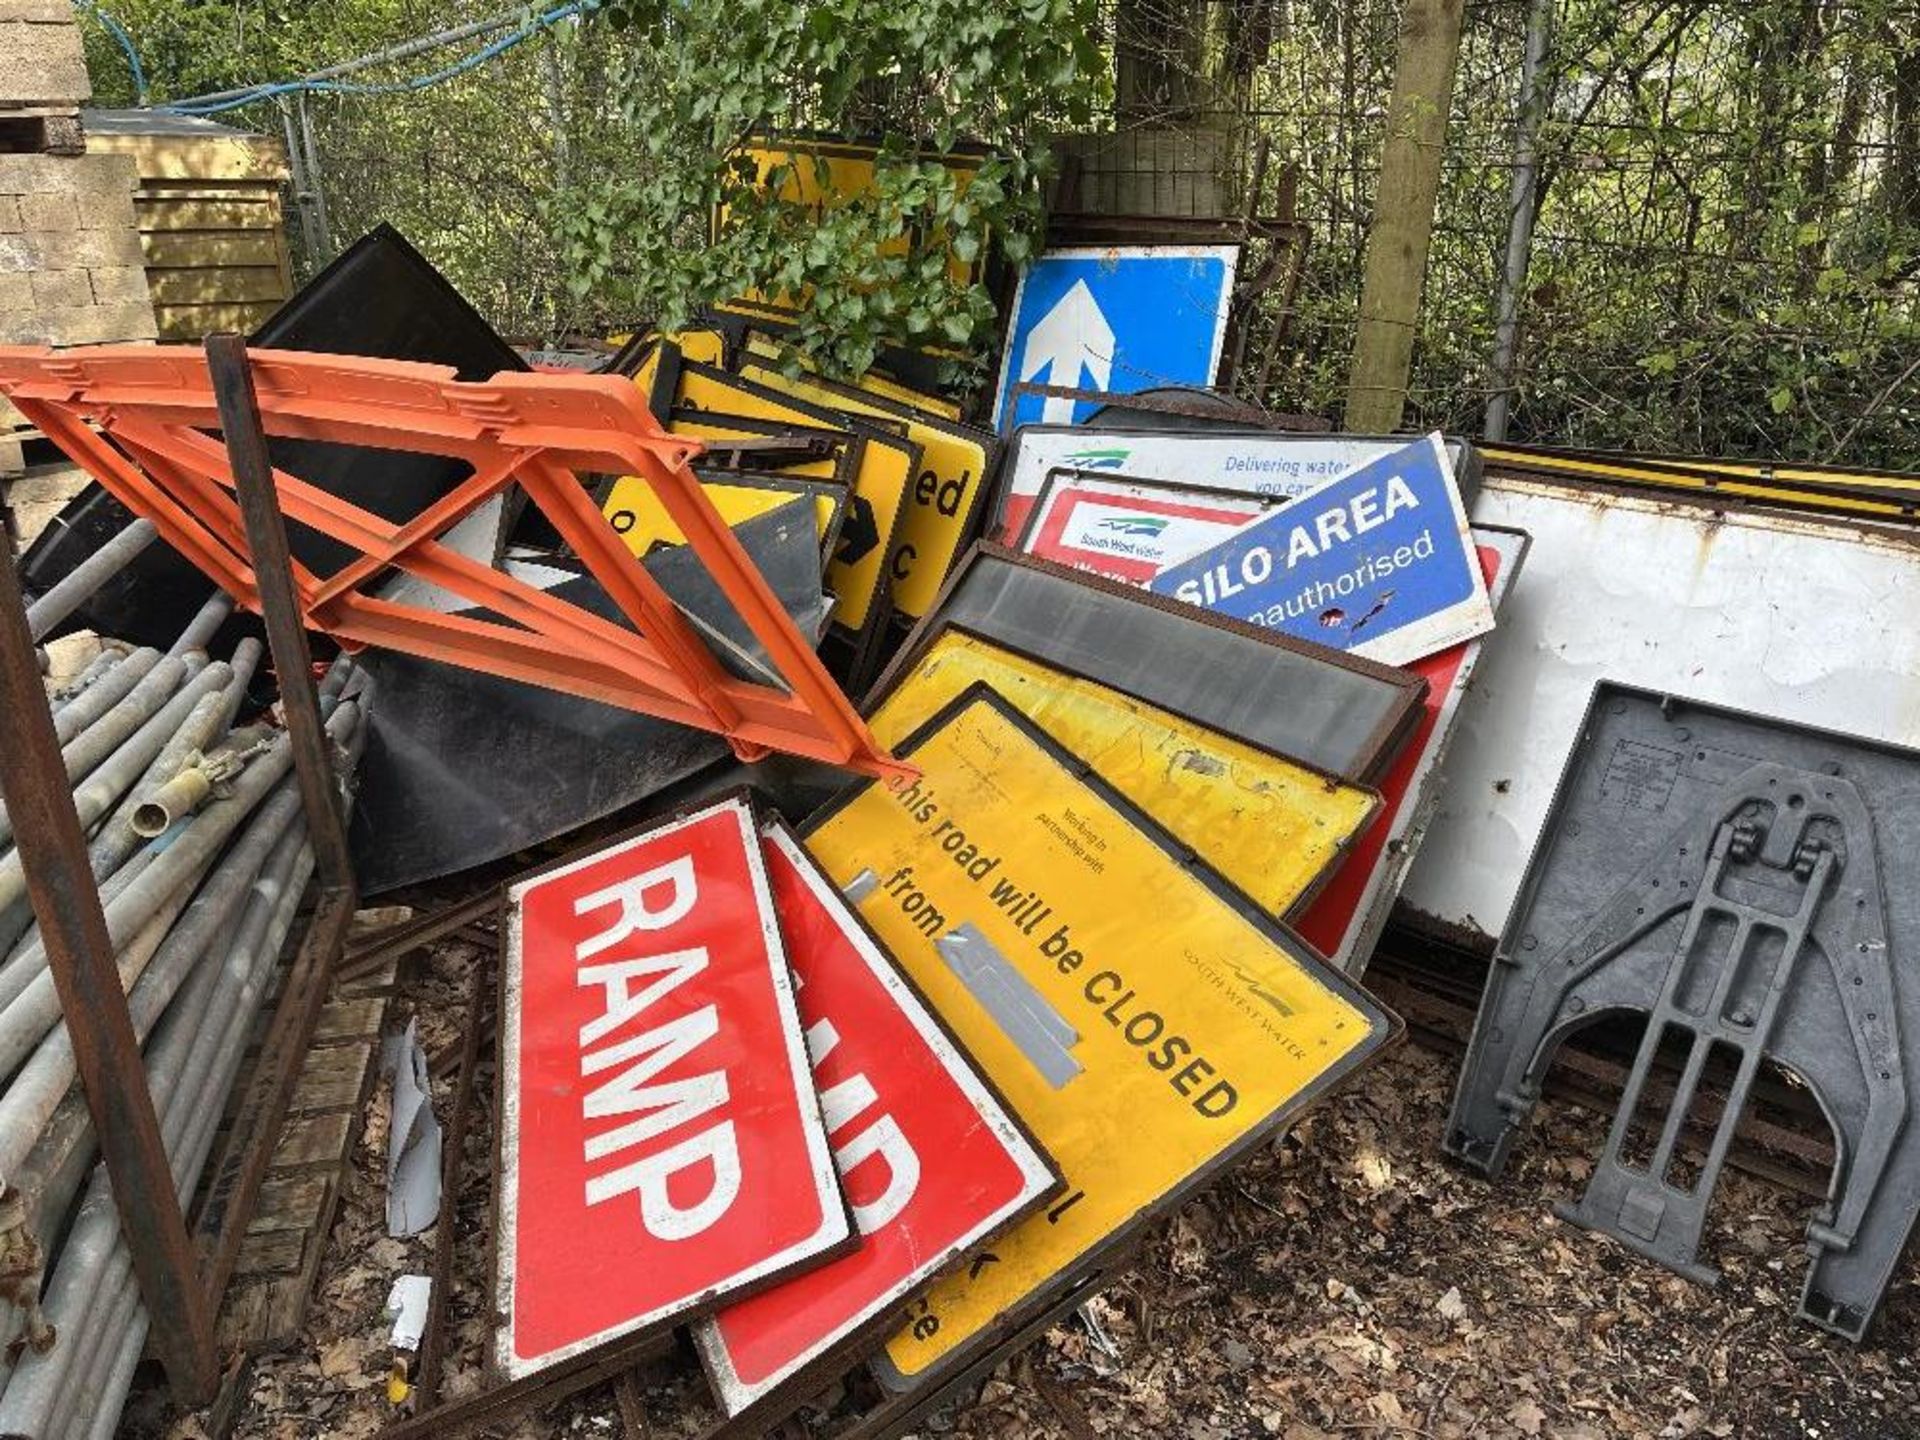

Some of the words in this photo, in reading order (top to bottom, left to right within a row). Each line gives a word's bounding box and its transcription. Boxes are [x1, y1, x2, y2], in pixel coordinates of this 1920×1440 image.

[916, 469, 970, 517] ed
[1225, 456, 1300, 477] Delivering
[1174, 547, 1272, 607] SILO
[1286, 475, 1420, 569] AREA
[1249, 529, 1434, 627] nauthorised
[1034, 813, 1086, 858] partnership
[1083, 853, 1106, 875] with
[1063, 808, 1098, 845] Working
[1096, 838, 1107, 852] in
[883, 866, 945, 938] from
[897, 779, 938, 824] his
[931, 818, 1002, 882] road
[989, 876, 1053, 936] will
[1038, 924, 1084, 975] be
[1084, 970, 1238, 1118] CLOSED
[574, 854, 742, 1242] RAMP
[1260, 1018, 1306, 1060] WATER
